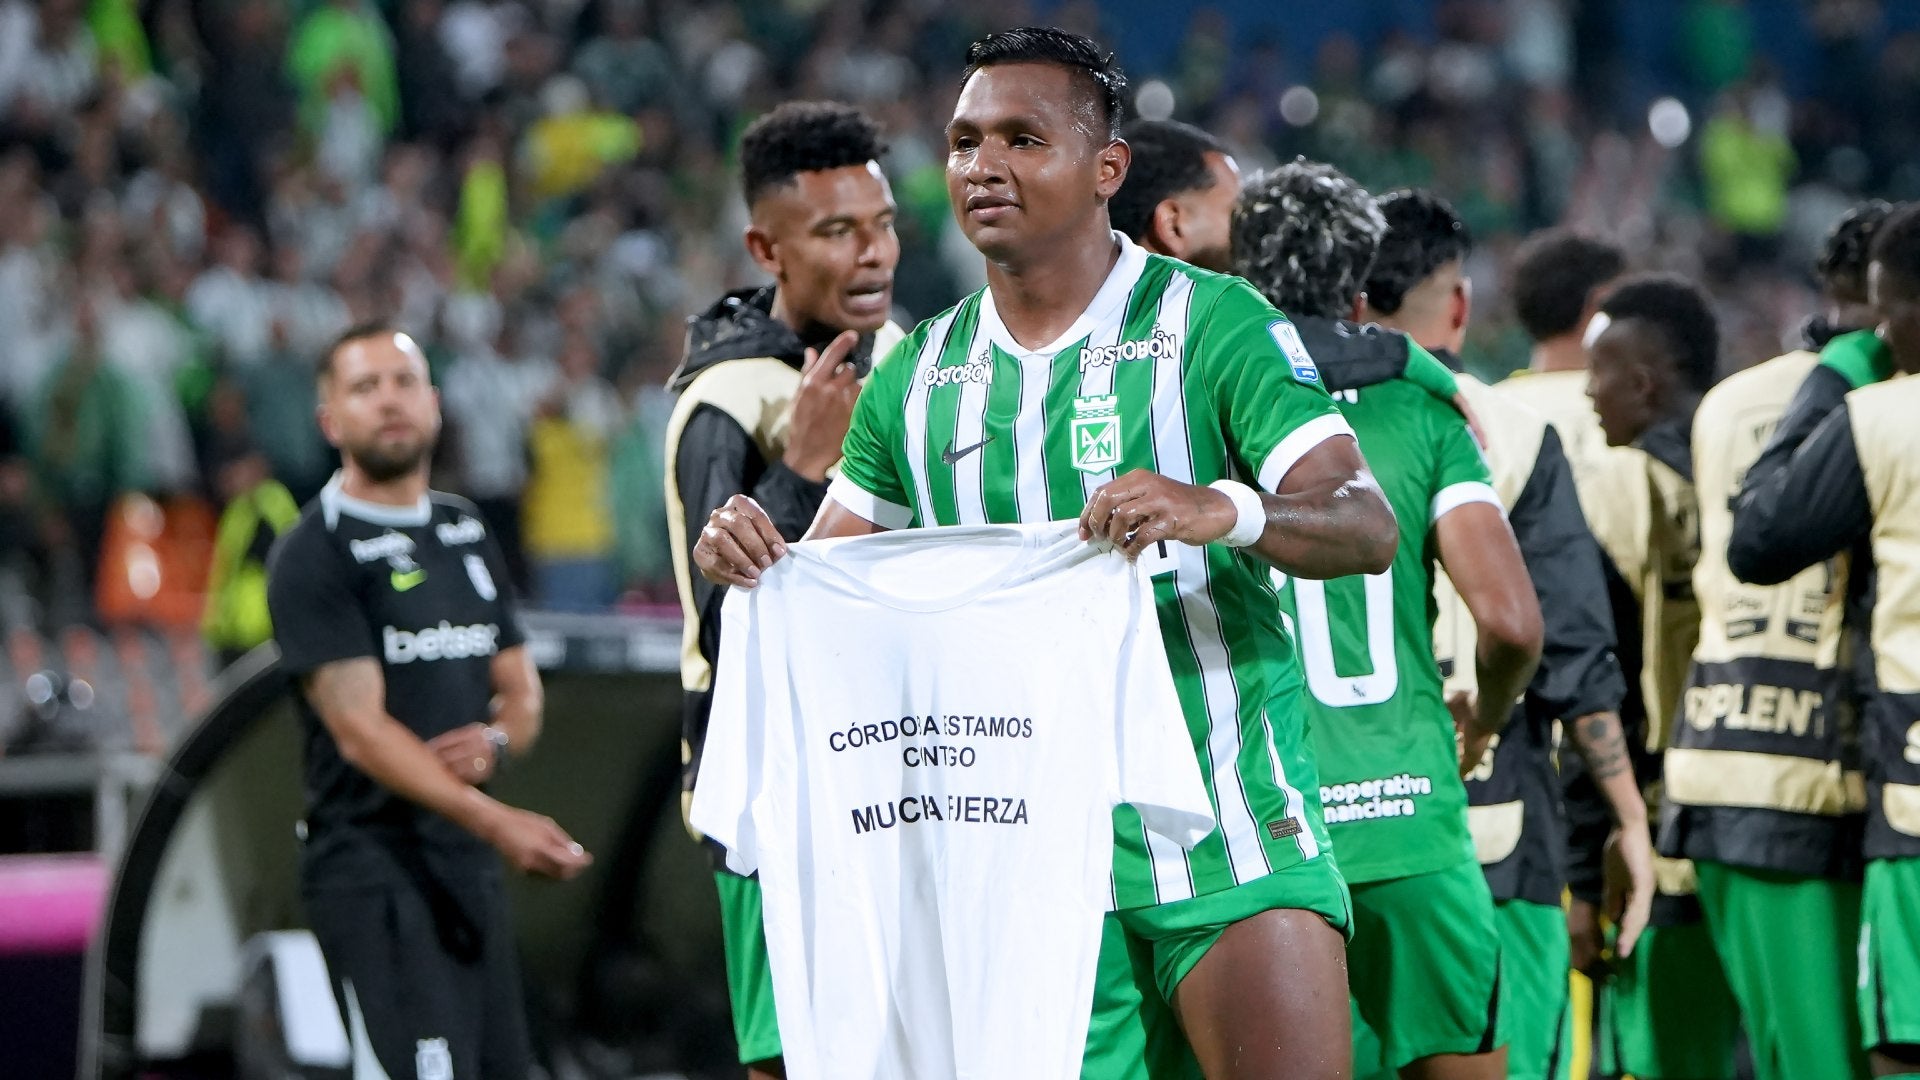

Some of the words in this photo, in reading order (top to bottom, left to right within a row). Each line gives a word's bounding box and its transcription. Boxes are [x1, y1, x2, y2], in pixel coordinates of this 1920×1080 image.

[829, 714, 941, 752] CÓRDOA
[943, 714, 1033, 739] STAMOS
[903, 745, 976, 768] CNTGO
[1319, 772, 1432, 805] ooperativa
[1323, 796, 1416, 825] nanciera
